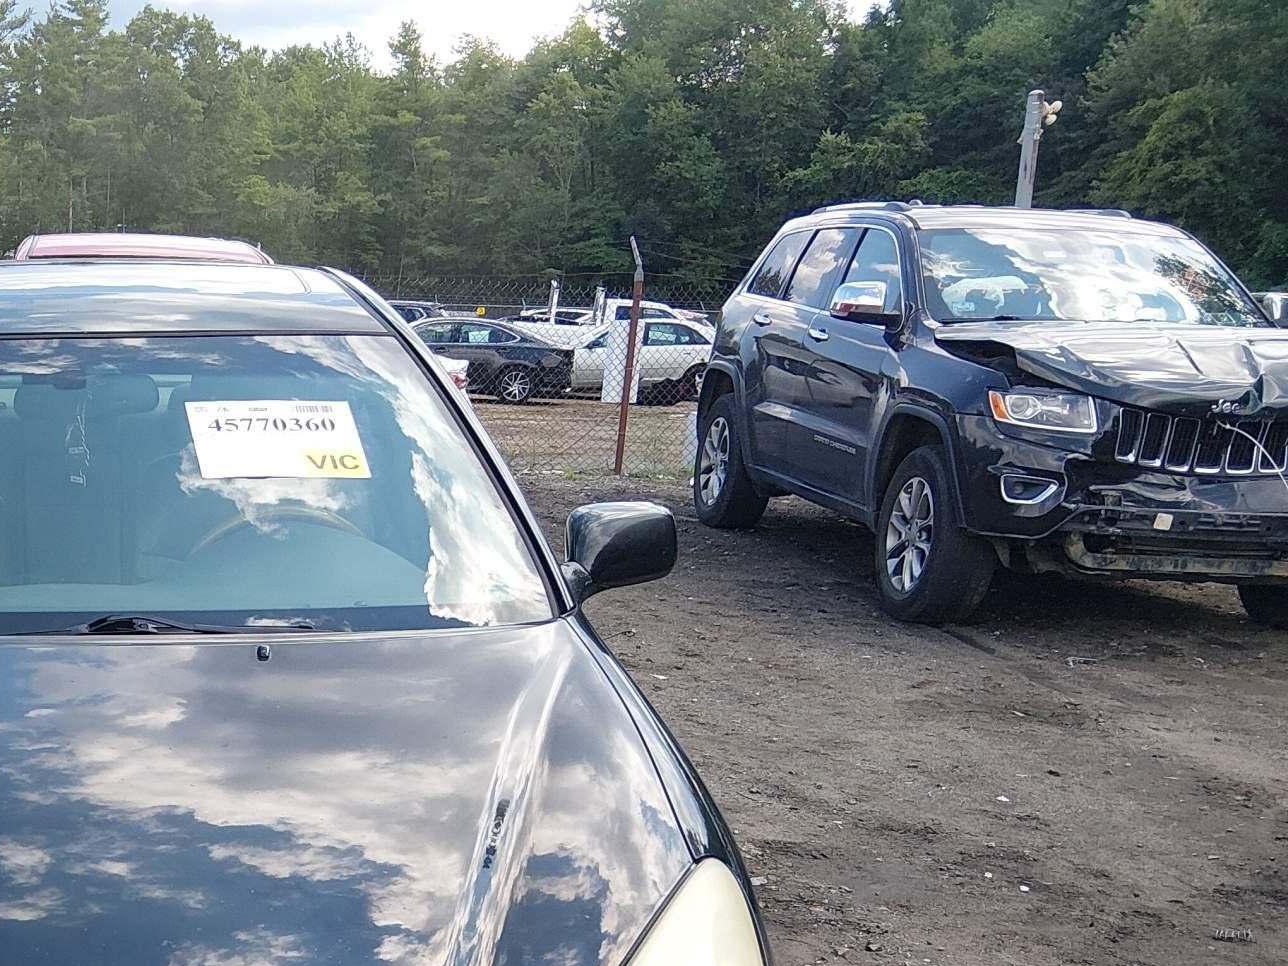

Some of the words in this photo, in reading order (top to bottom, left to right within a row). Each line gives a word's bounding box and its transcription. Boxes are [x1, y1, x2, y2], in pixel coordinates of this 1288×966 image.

[1211, 398, 1241, 414] Jee
[208, 417, 336, 432] 45770360
[306, 454, 361, 470] VIC
